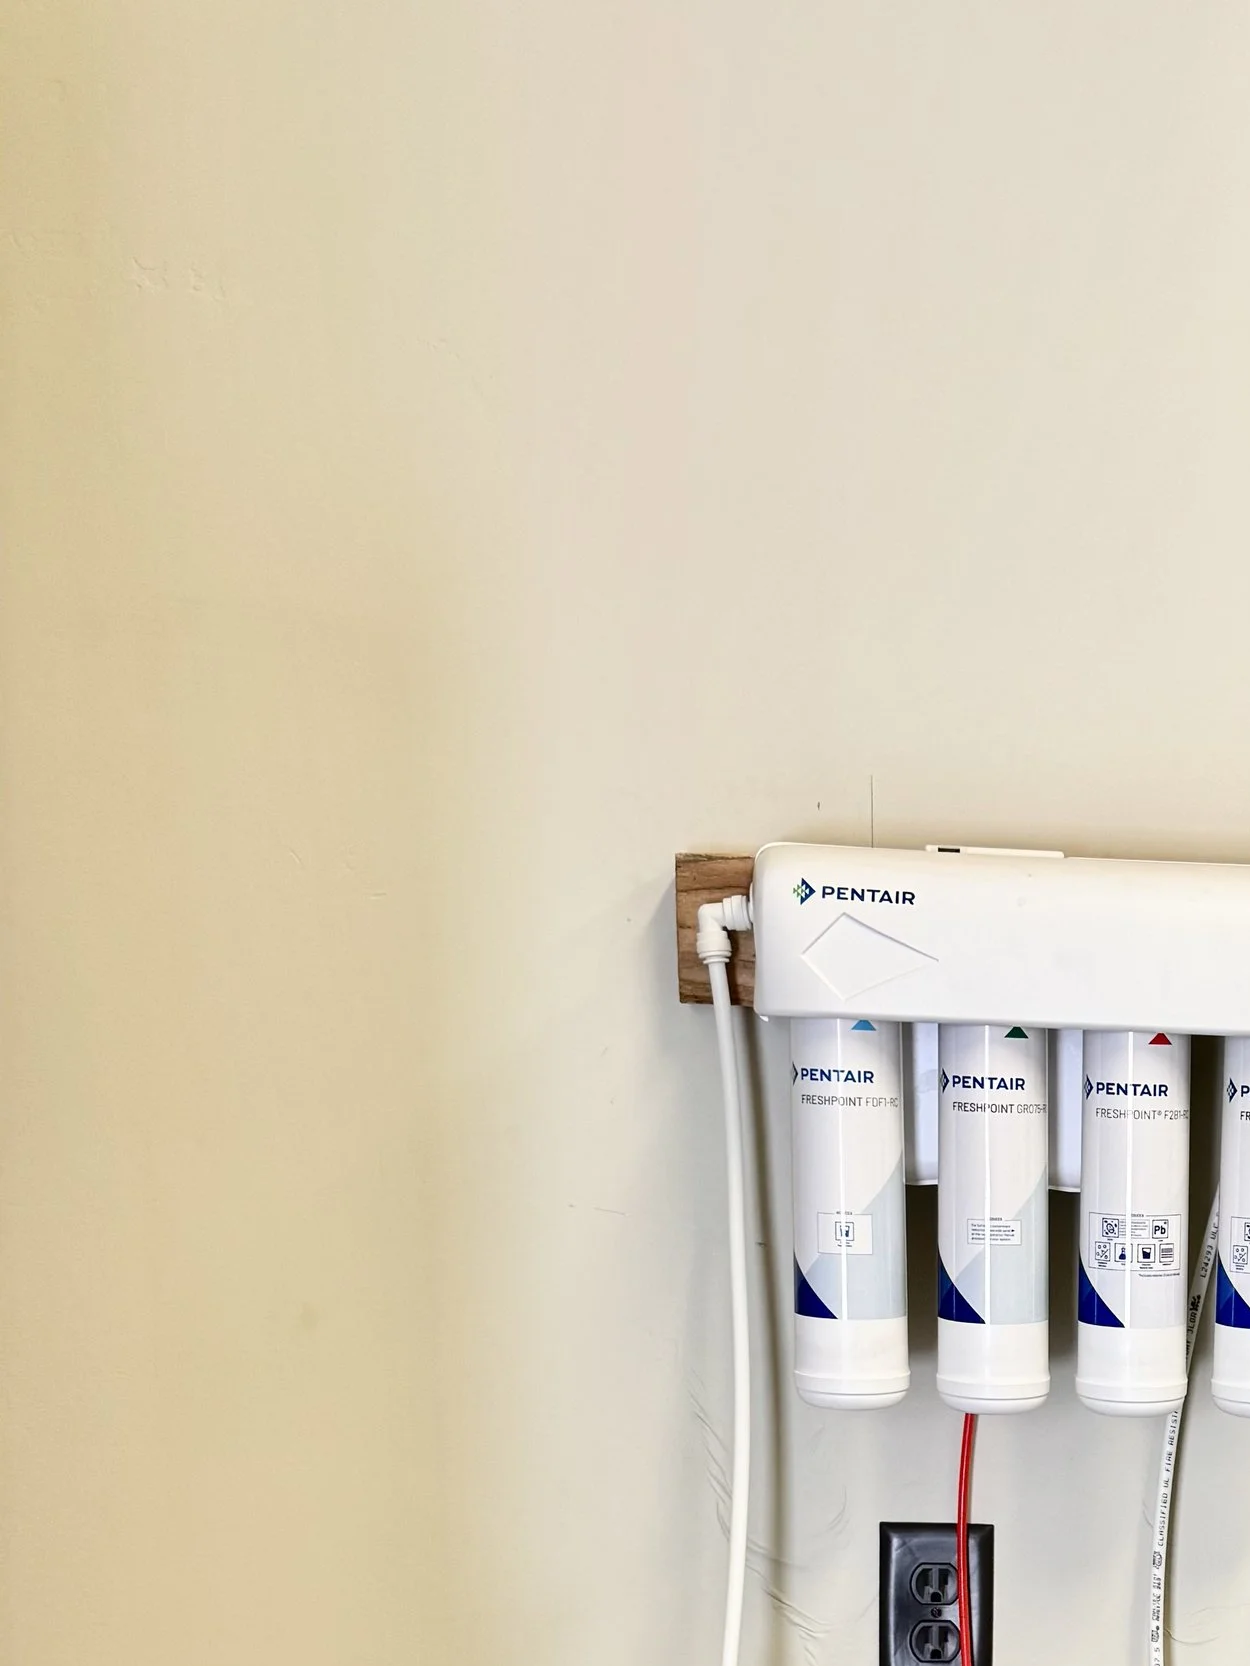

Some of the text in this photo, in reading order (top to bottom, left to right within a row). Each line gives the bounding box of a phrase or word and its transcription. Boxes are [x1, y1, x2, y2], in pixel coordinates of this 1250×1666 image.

[822, 885, 916, 905] PENTAIR
[800, 1067, 875, 1083] PENTAIR
[952, 1074, 1026, 1090] PENTAIR
[1096, 1081, 1169, 1097] PENTAIR
[801, 1094, 863, 1107] FRESHPOINT
[952, 1101, 1015, 1114] FRESHPOINT
[1153, 1225, 1167, 1235] Pb
[1157, 1492, 1168, 1547] CLASSIFIED
